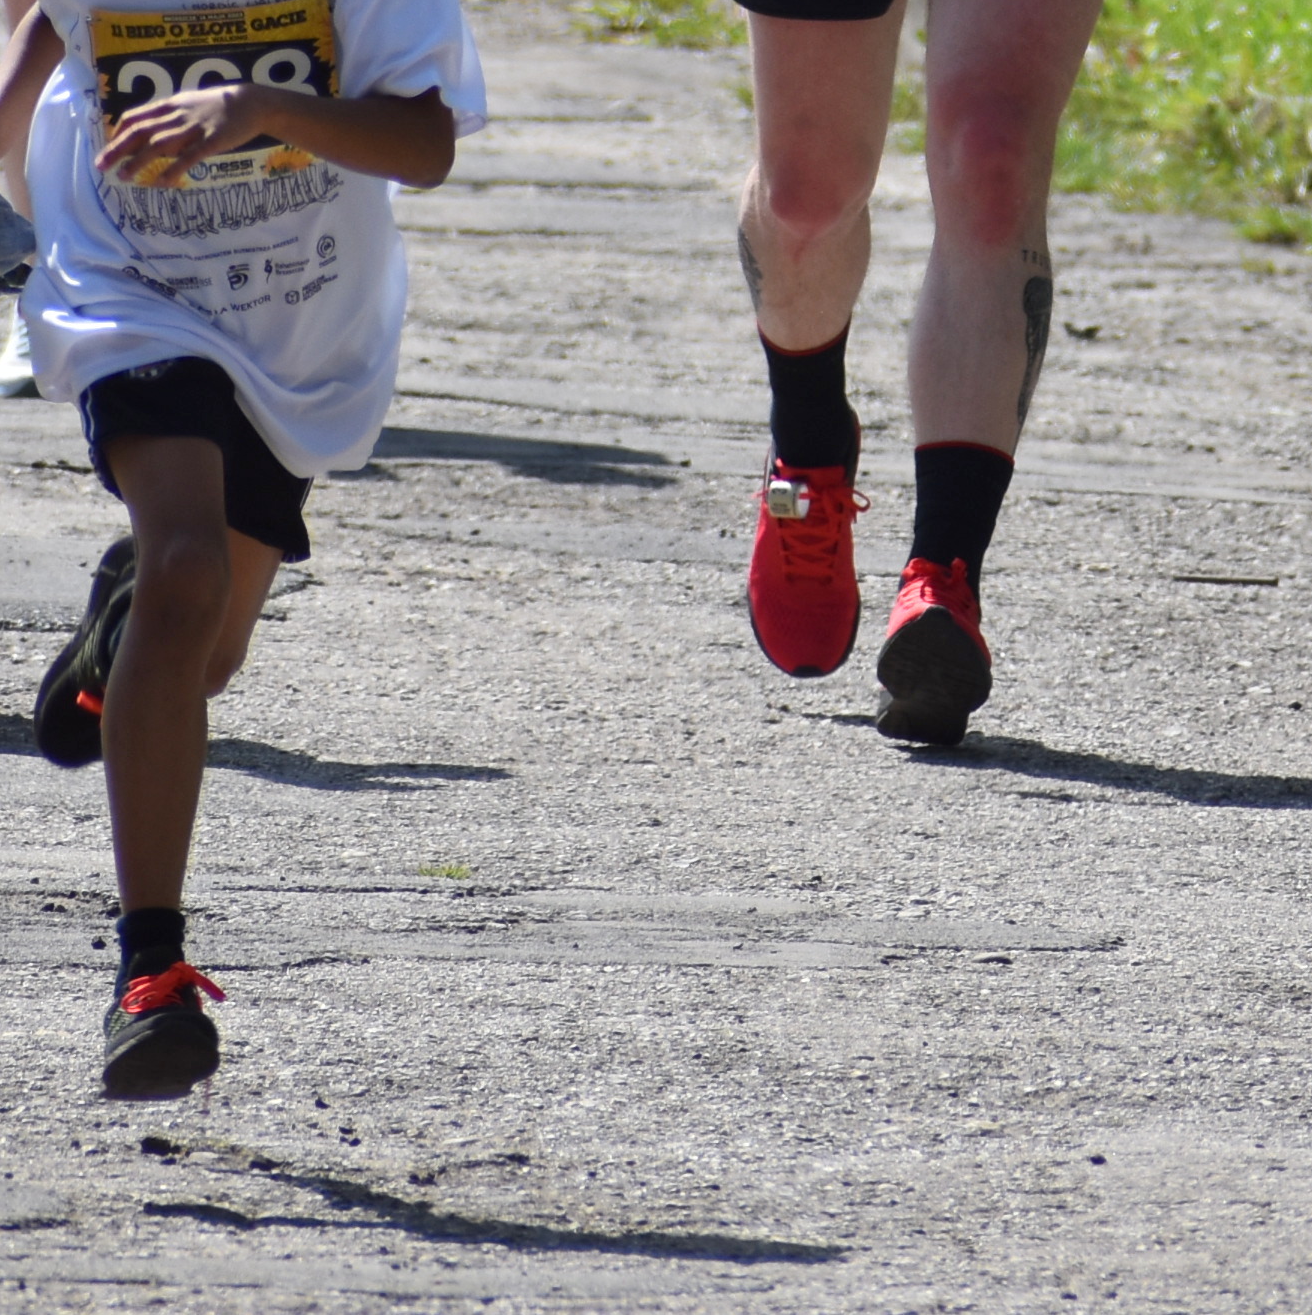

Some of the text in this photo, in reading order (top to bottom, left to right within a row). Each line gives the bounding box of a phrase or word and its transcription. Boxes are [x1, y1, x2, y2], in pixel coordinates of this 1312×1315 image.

[111, 10, 307, 39] 11 BIEG O ZŁOTE GACIE
[209, 158, 254, 173] nessi
[230, 294, 271, 312] WEKTOR
